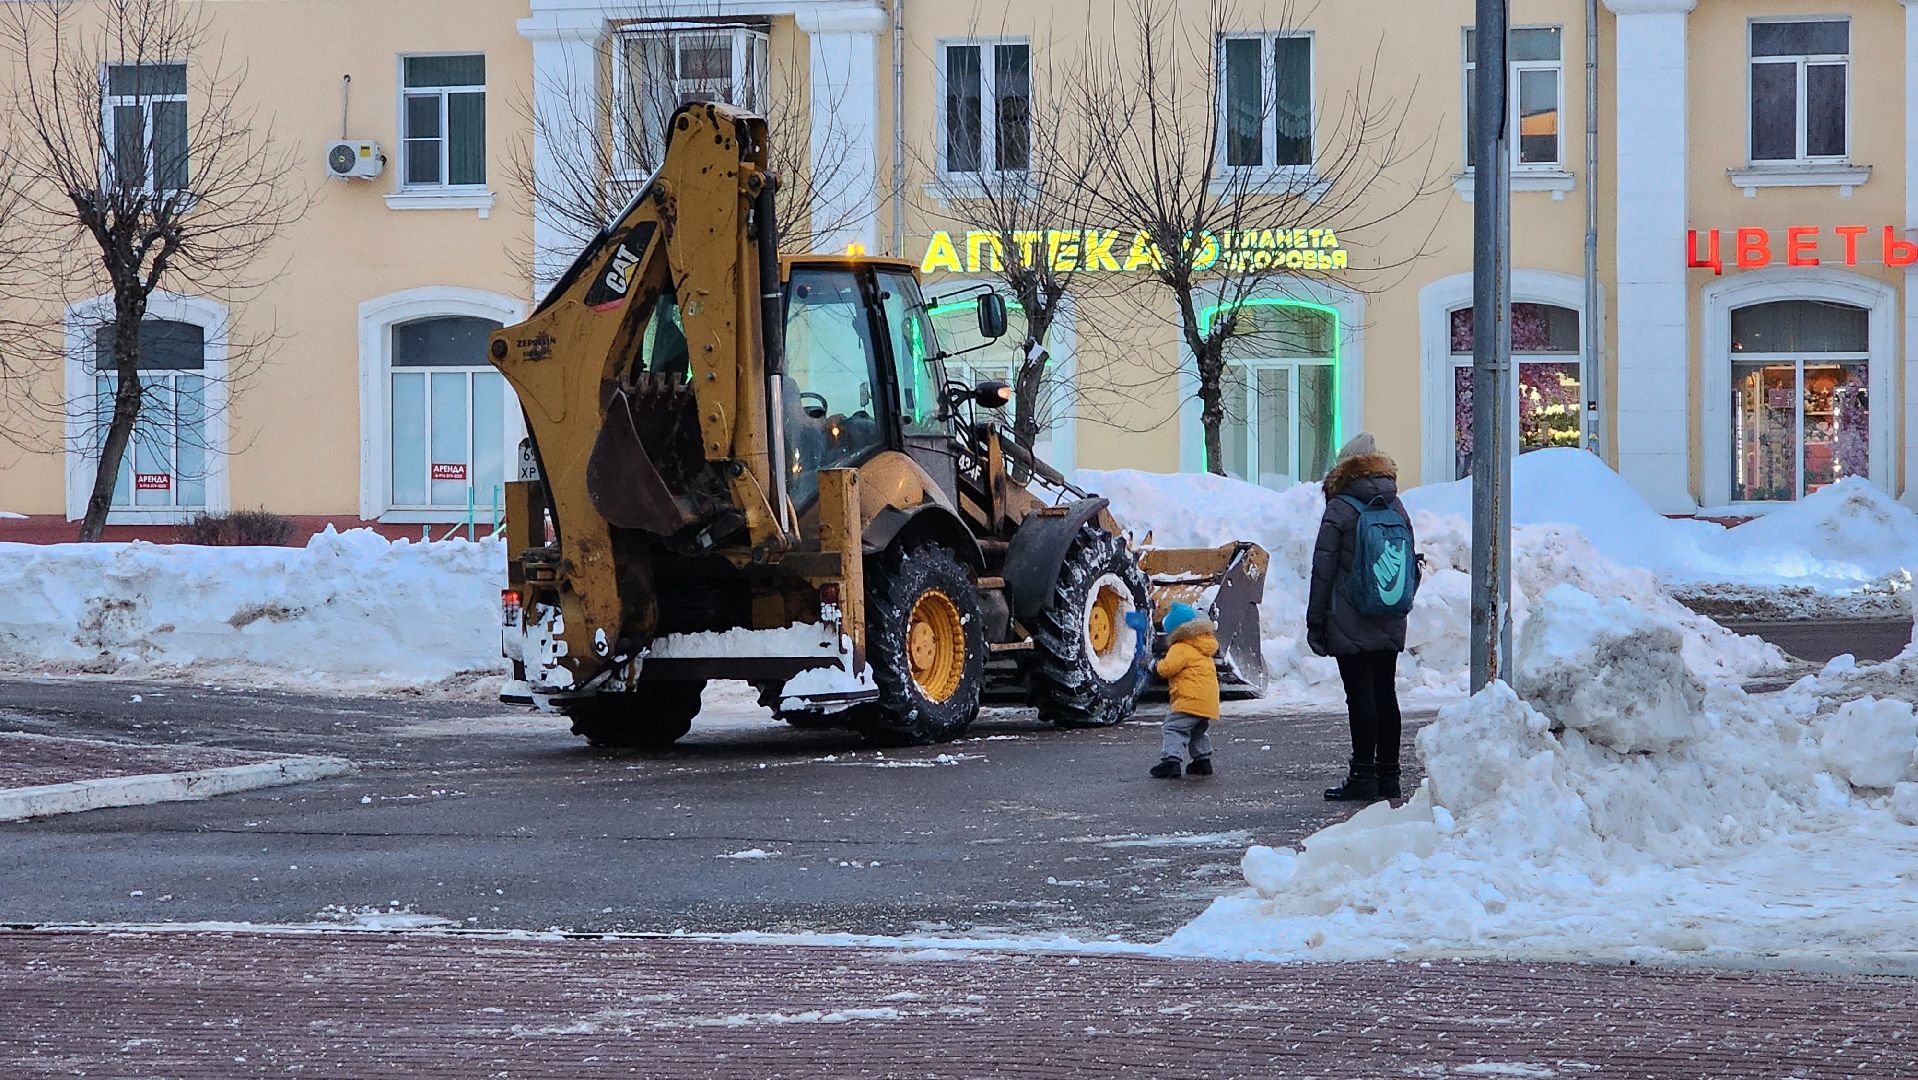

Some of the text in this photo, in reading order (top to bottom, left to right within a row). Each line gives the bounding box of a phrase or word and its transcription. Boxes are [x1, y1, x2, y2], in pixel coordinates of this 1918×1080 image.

[920, 229, 1168, 274] АПТЕКА
[1223, 228, 1340, 249] ПЛАНЕТА
[605, 243, 640, 294] CAT
[138, 475, 168, 484] АРЕНДА
[433, 465, 465, 474] АРЕНДА
[1373, 540, 1402, 588] NIKE
